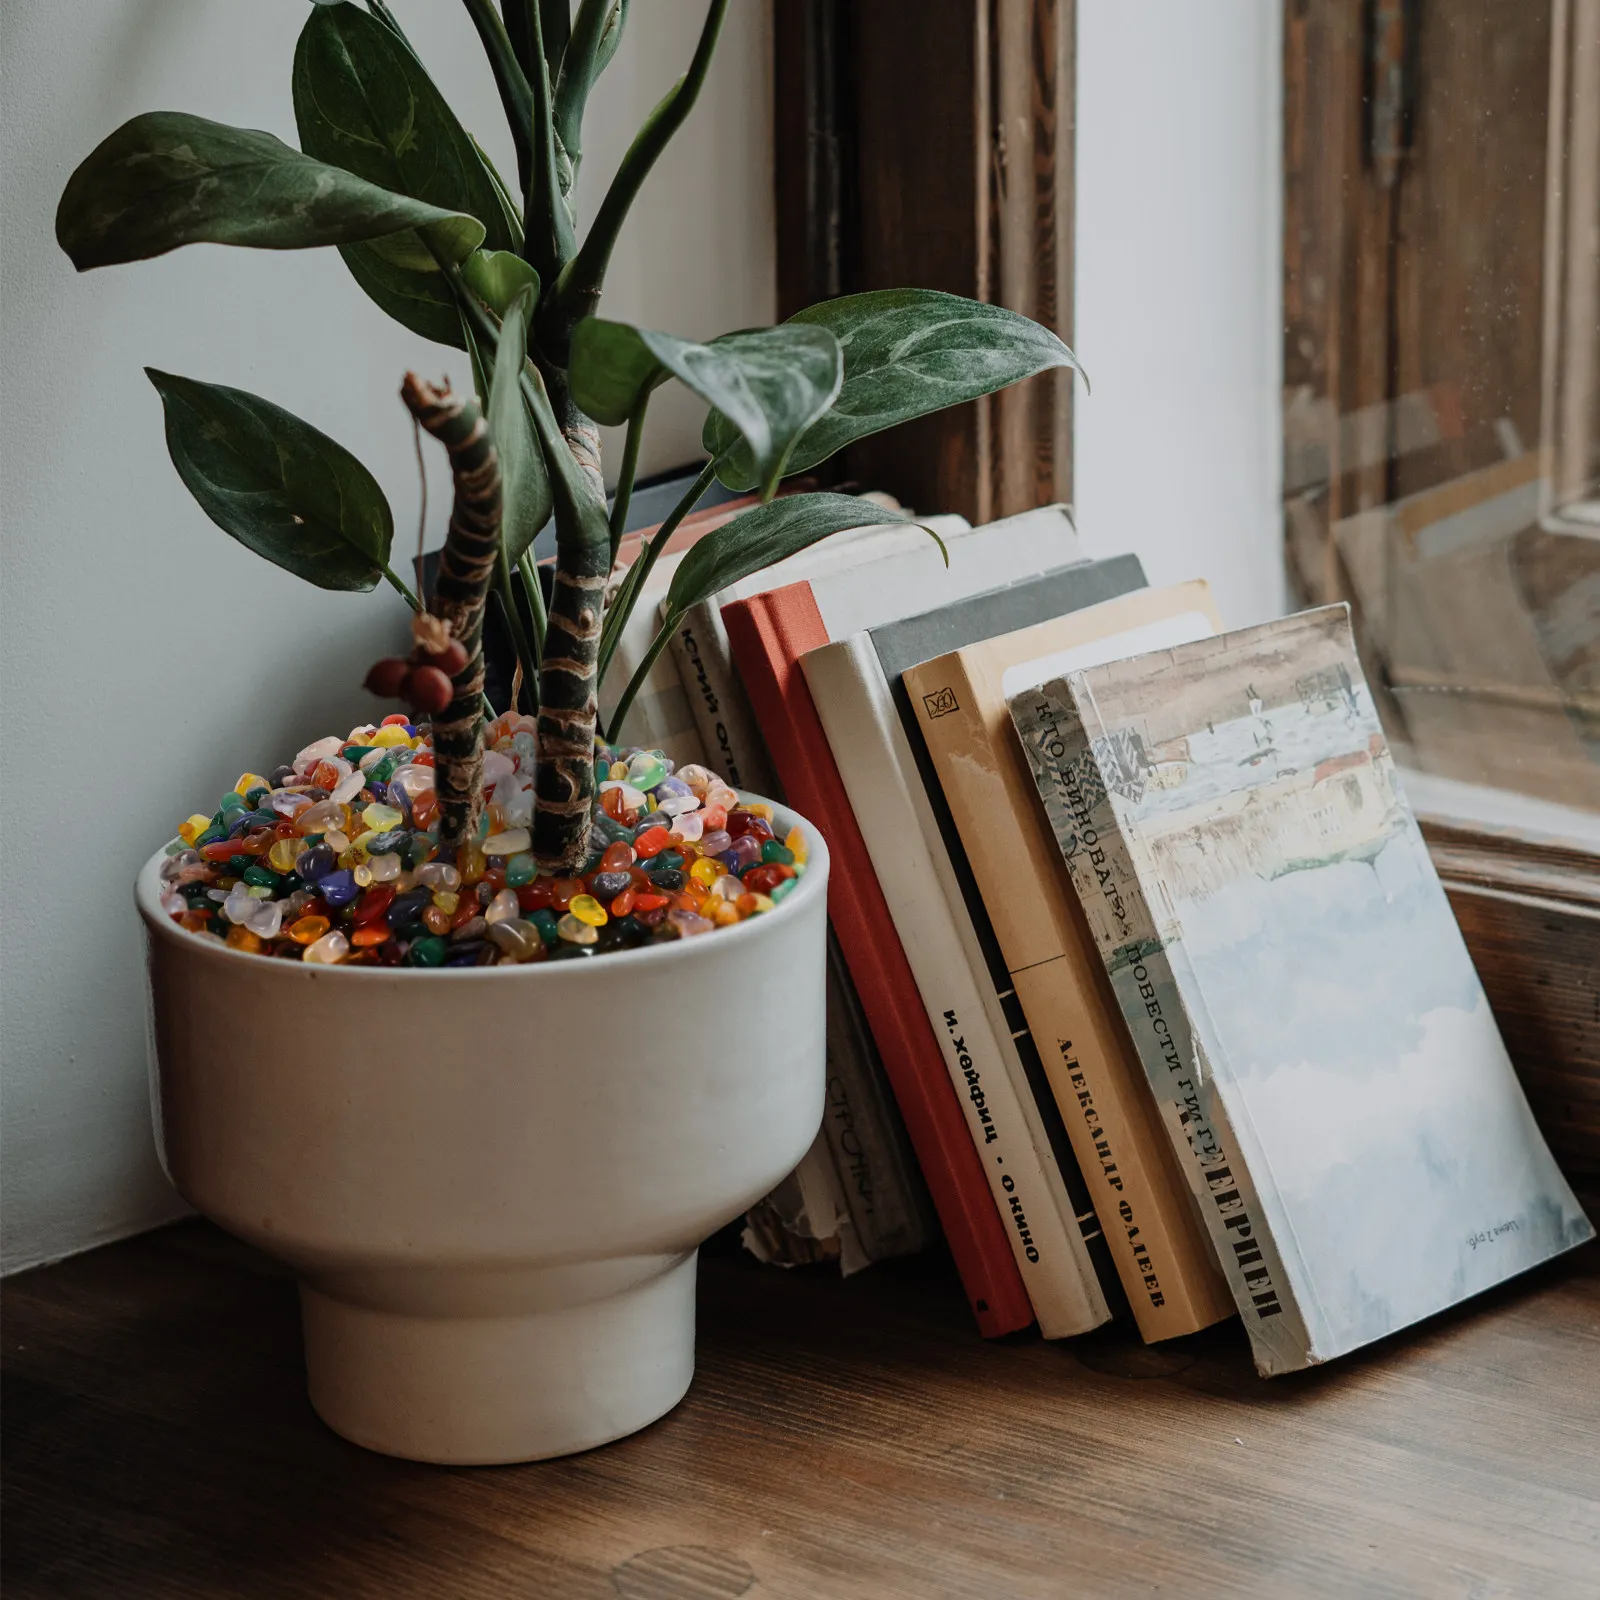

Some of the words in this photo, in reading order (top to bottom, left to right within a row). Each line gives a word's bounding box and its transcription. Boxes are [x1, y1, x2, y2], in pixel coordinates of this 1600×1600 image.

[681, 628, 718, 714] ЮРИЙ
[716, 722, 744, 790] ОЛЕ
[1035, 702, 1065, 759] КТО
[1060, 766, 1131, 936] ВИНОВАТ?
[1124, 943, 1182, 1074] ПОВЕСТИ
[1057, 1037, 1123, 1192] АЛЕКСАНДР
[1118, 1200, 1166, 1309] ФАДЕЕВ
